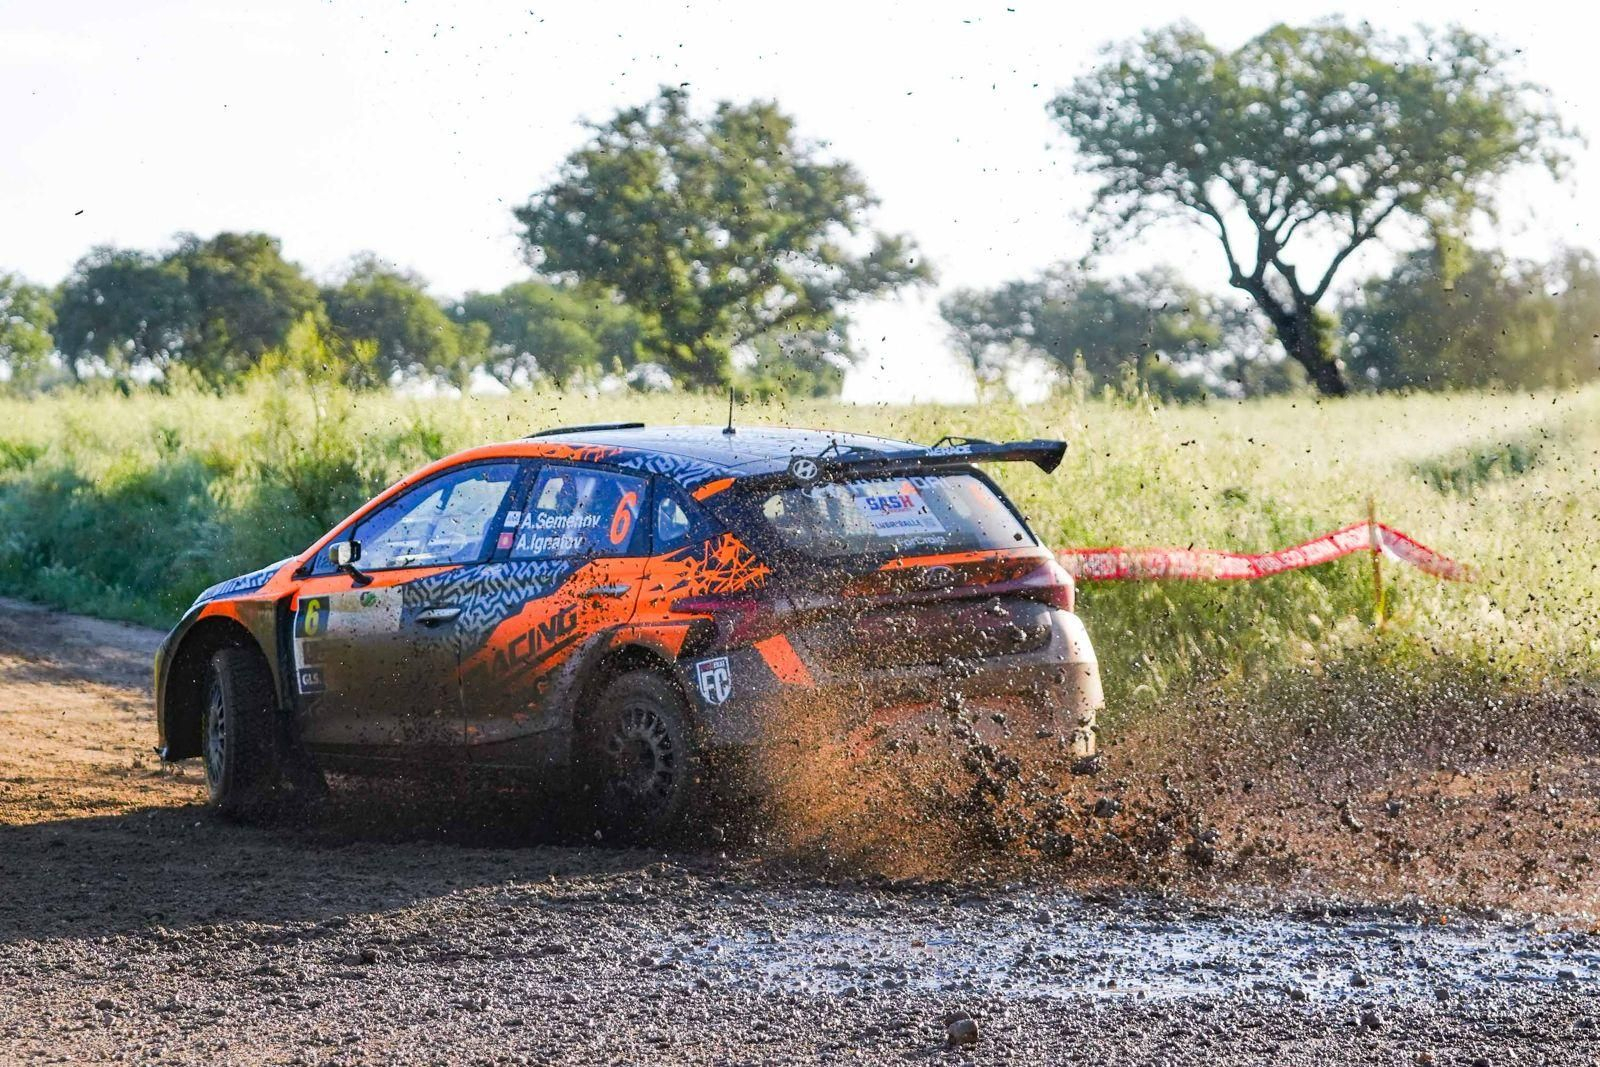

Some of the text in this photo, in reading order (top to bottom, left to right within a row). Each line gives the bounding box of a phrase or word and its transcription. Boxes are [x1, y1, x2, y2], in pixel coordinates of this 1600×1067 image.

[609, 490, 638, 545] 6
[865, 494, 915, 511] SASH
[304, 598, 321, 636] 6
[701, 667, 731, 702] FC
